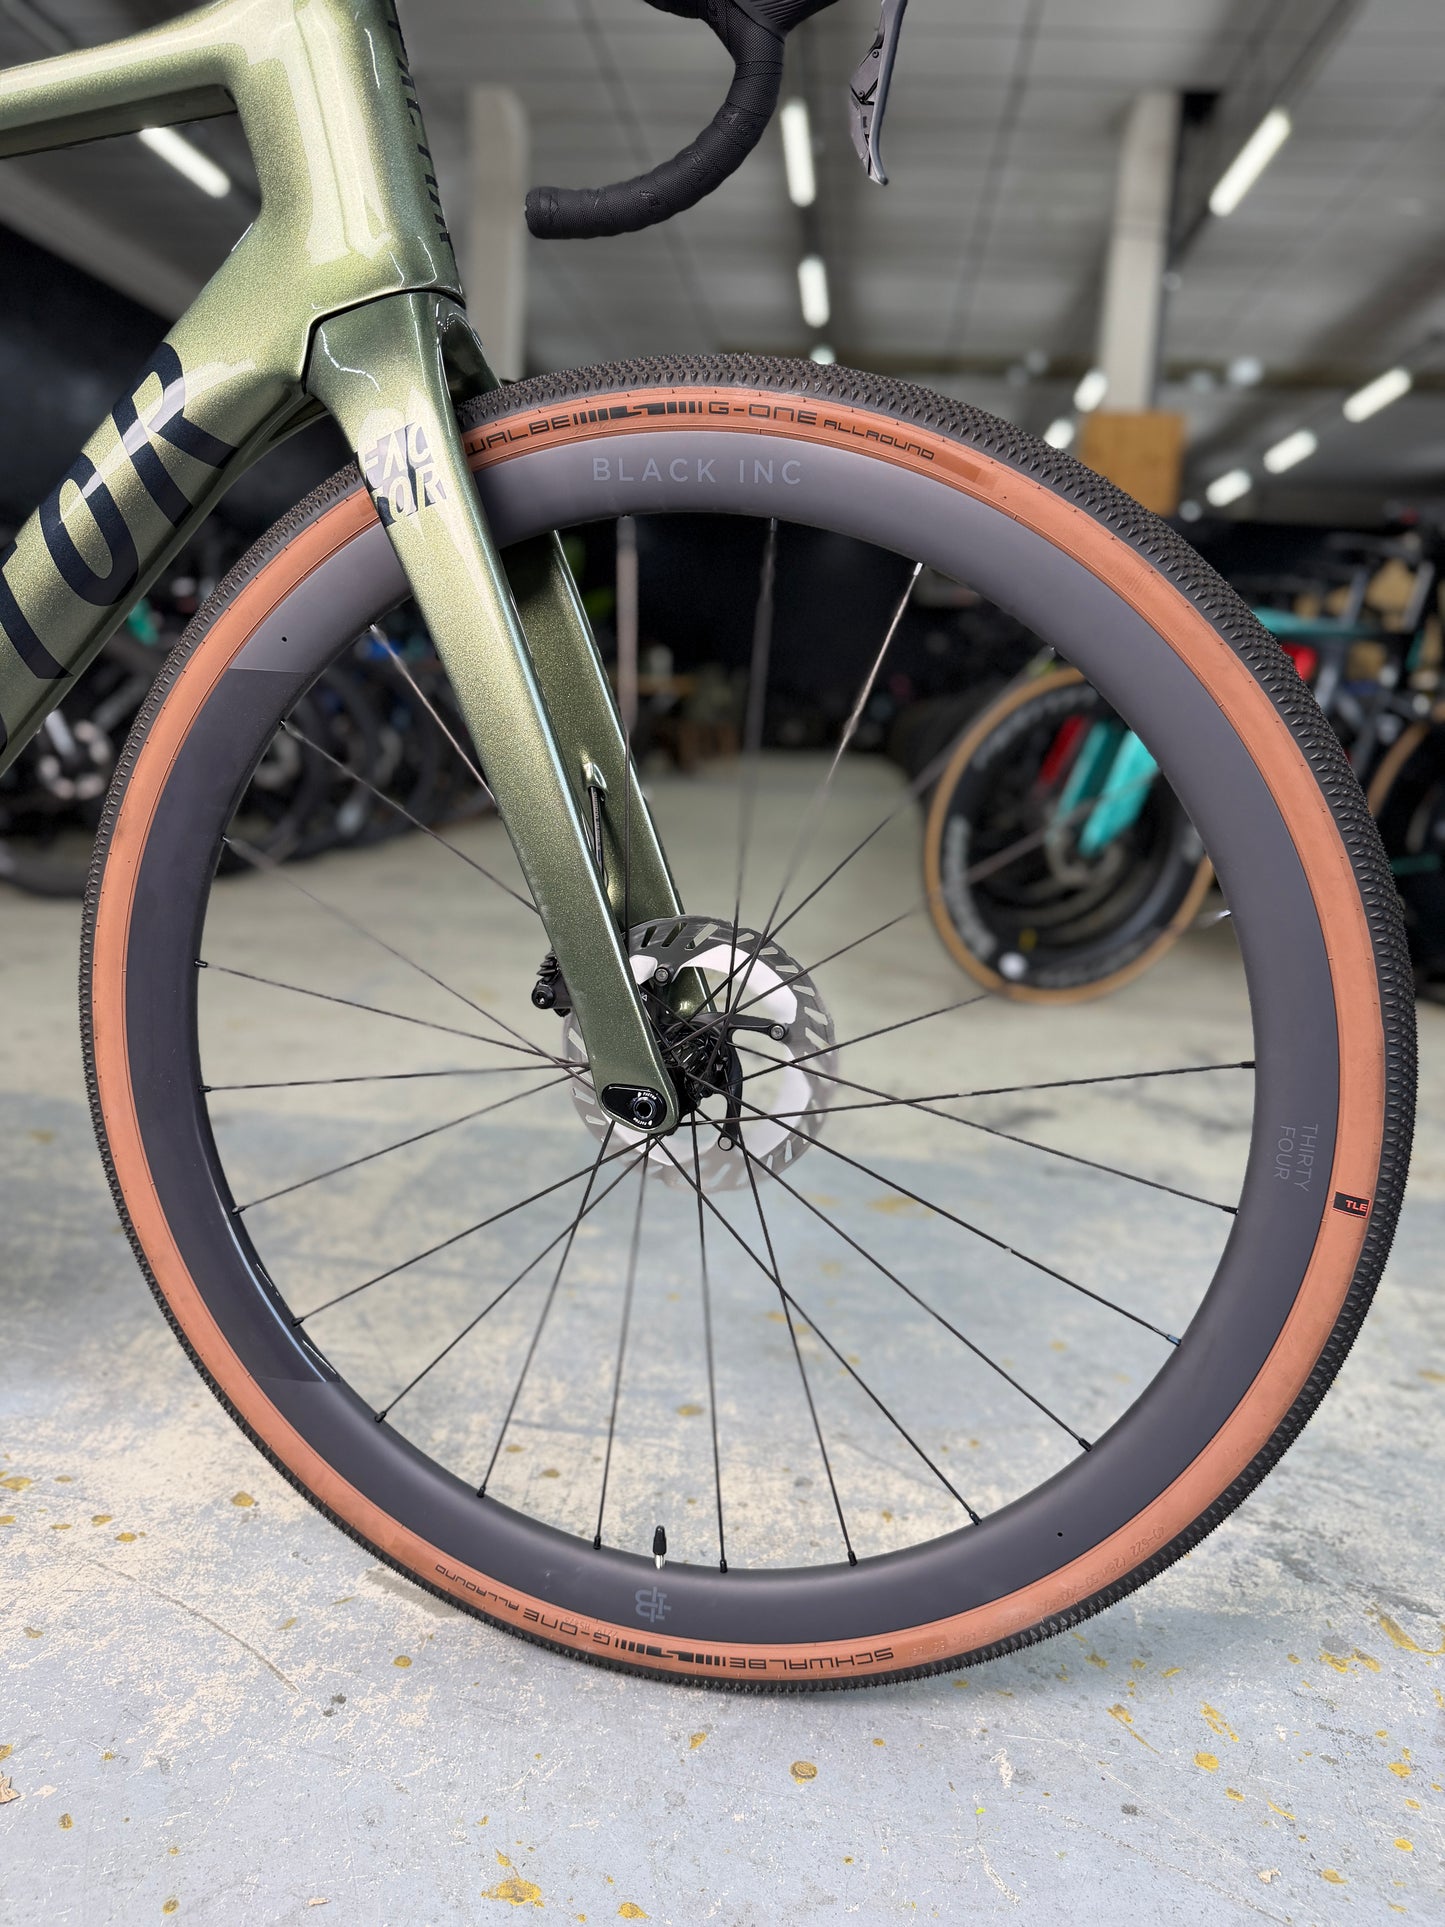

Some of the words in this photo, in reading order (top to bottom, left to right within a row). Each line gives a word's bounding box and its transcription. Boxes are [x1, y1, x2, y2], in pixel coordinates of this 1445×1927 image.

[468, 415, 571, 457] WALBE
[708, 402, 817, 426] G-ONE
[824, 419, 935, 461] ALLROUND
[593, 456, 718, 484] BLACK
[738, 457, 802, 486] INC
[0, 342, 240, 756] TOR
[1273, 1125, 1296, 1180] FOUR
[1294, 1123, 1319, 1192] THIRTY
[1345, 1199, 1368, 1213] TLE
[435, 1564, 520, 1611] ALLROUND
[522, 1608, 611, 1646] G-ONE
[730, 1647, 895, 1670] SCHWALBE
